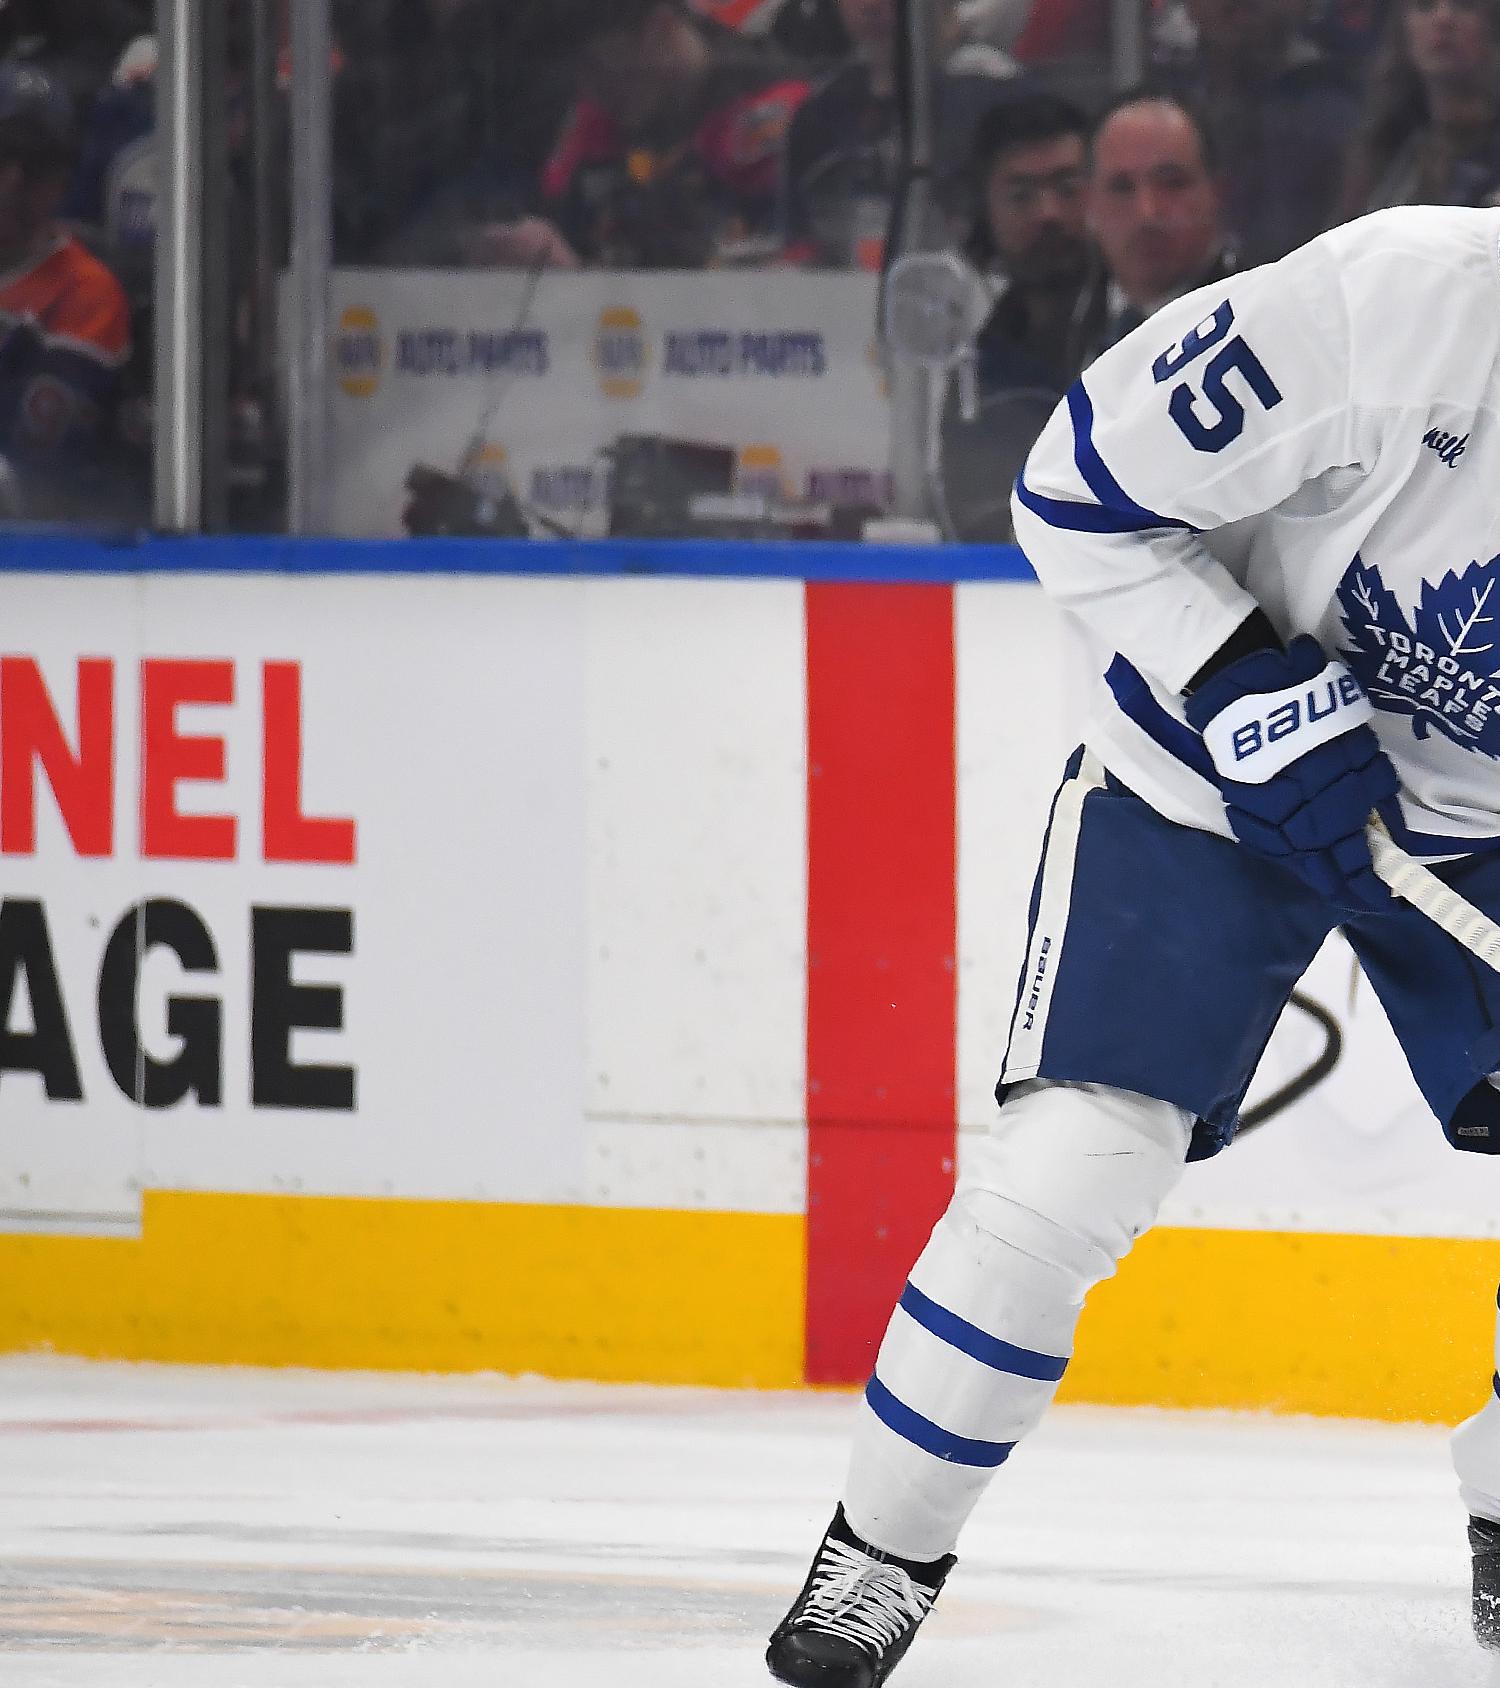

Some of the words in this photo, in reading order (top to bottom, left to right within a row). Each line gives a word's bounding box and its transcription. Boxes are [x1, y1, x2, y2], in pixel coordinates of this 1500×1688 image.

[1152, 298, 1284, 454] 95
[1376, 662, 1489, 733] LEAFS
[1384, 648, 1493, 721] MAPLE
